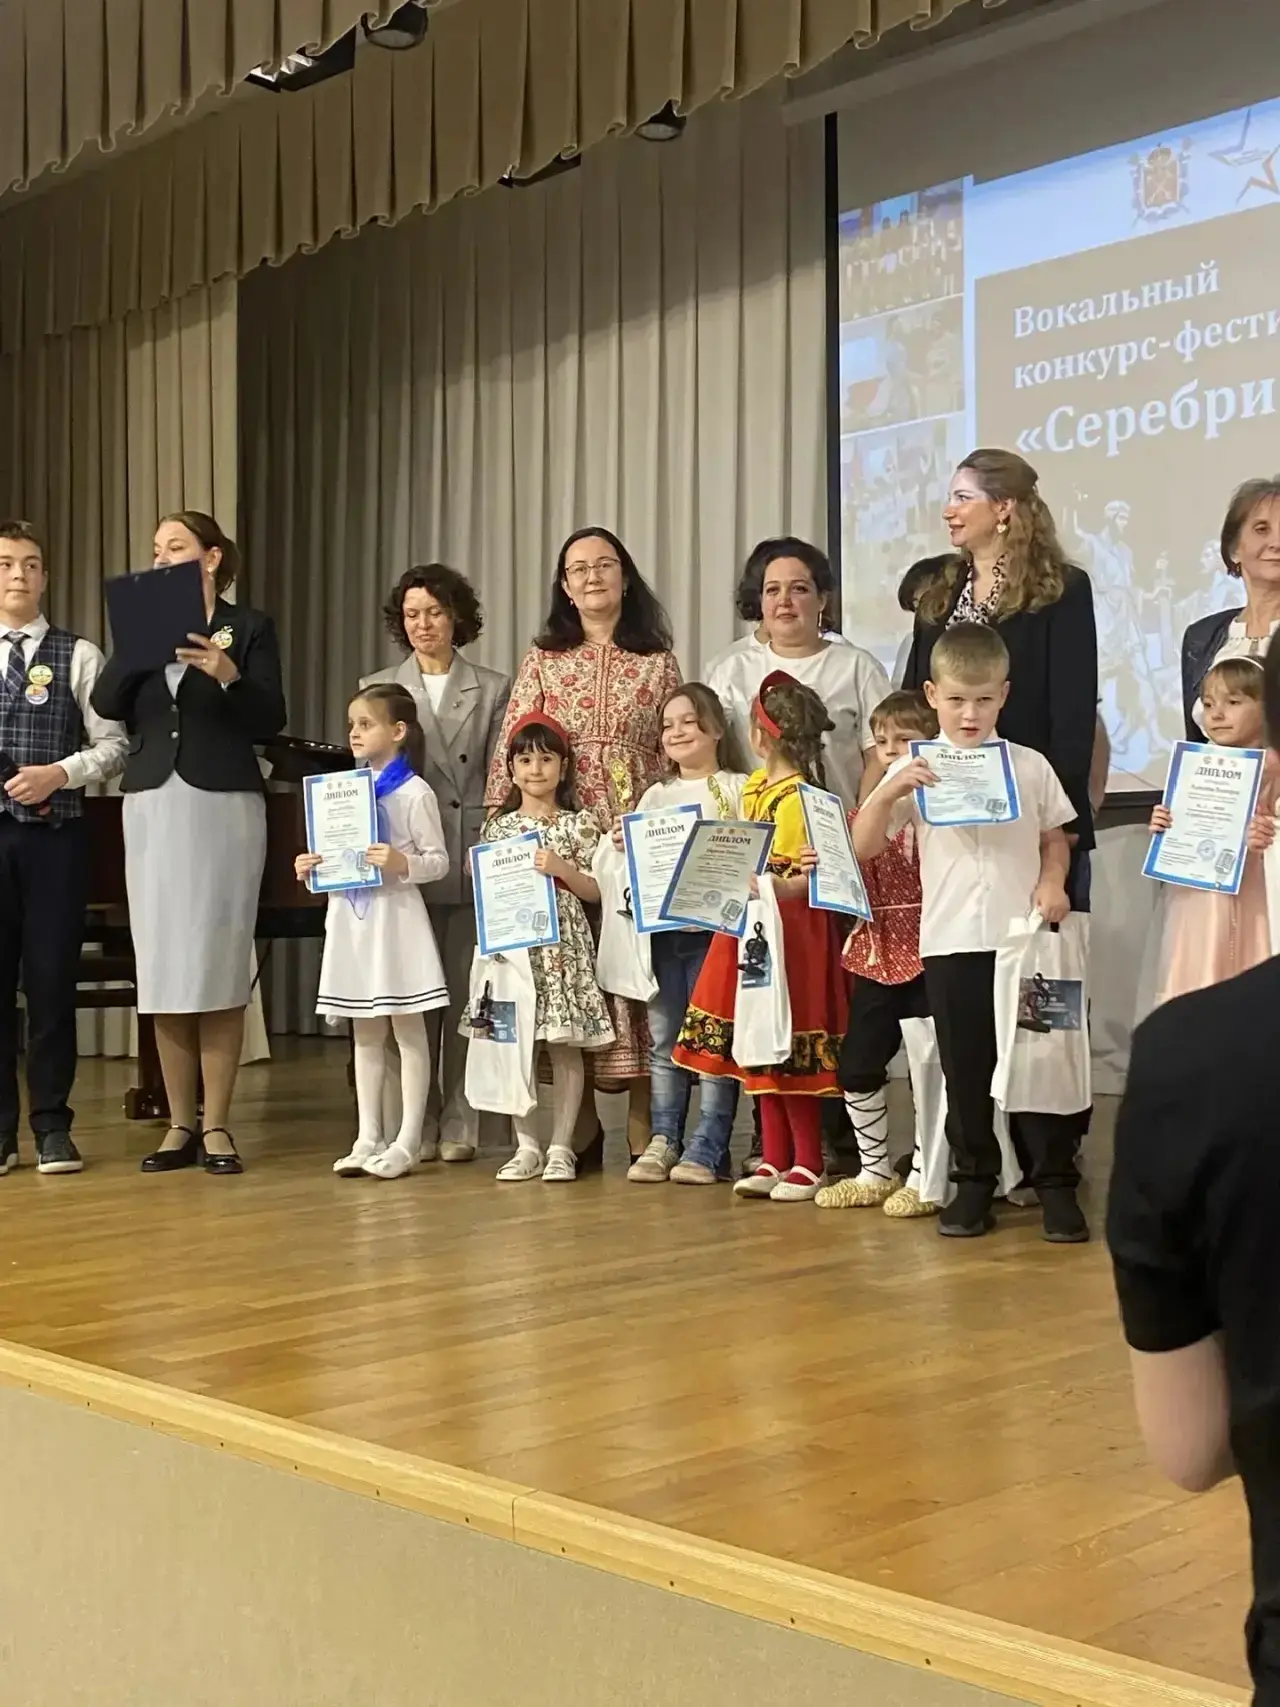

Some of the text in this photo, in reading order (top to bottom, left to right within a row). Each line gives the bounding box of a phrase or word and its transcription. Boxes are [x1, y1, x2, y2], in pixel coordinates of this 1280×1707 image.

[1014, 260, 1220, 339] Вокальный
[936, 752, 986, 761] ДИПЛОМ
[1194, 766, 1242, 780] ДИПЛОМ
[323, 789, 359, 801] ДИПЛОМ
[644, 824, 685, 839] ДИПЛОМ
[707, 834, 752, 845] ДИПЛОМ
[492, 852, 531, 868] ДИПЛОМ
